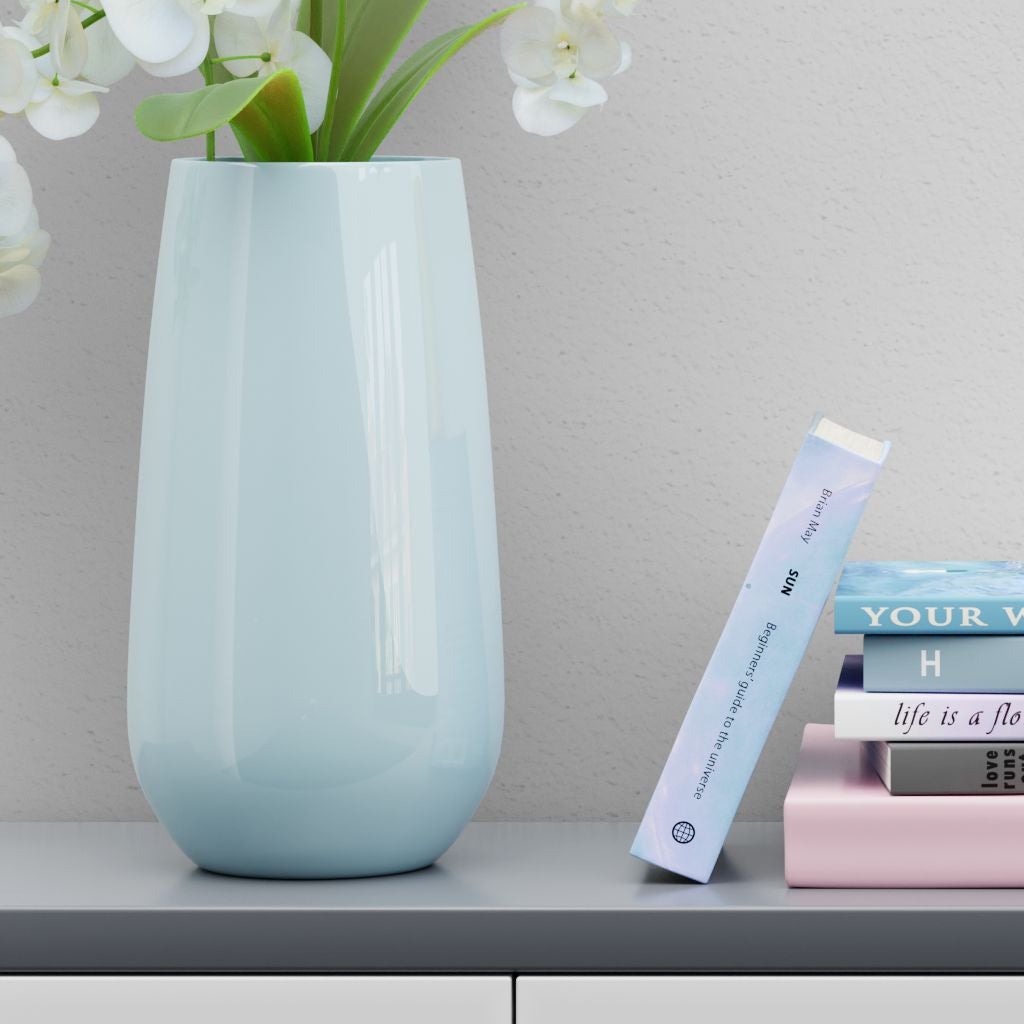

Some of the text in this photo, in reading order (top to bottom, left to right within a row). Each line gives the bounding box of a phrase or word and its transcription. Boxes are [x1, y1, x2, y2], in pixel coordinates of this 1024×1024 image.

[800, 488, 833, 544] Brian May
[780, 568, 799, 596] SUN
[860, 606, 988, 627] YOUR
[729, 680, 749, 714] guide
[723, 716, 735, 729] to
[894, 702, 930, 735] life
[941, 705, 957, 726] is
[968, 710, 985, 726] a
[714, 731, 729, 750] the
[693, 752, 719, 800] universe
[981, 749, 999, 788] love
[1003, 748, 1016, 790] runs
